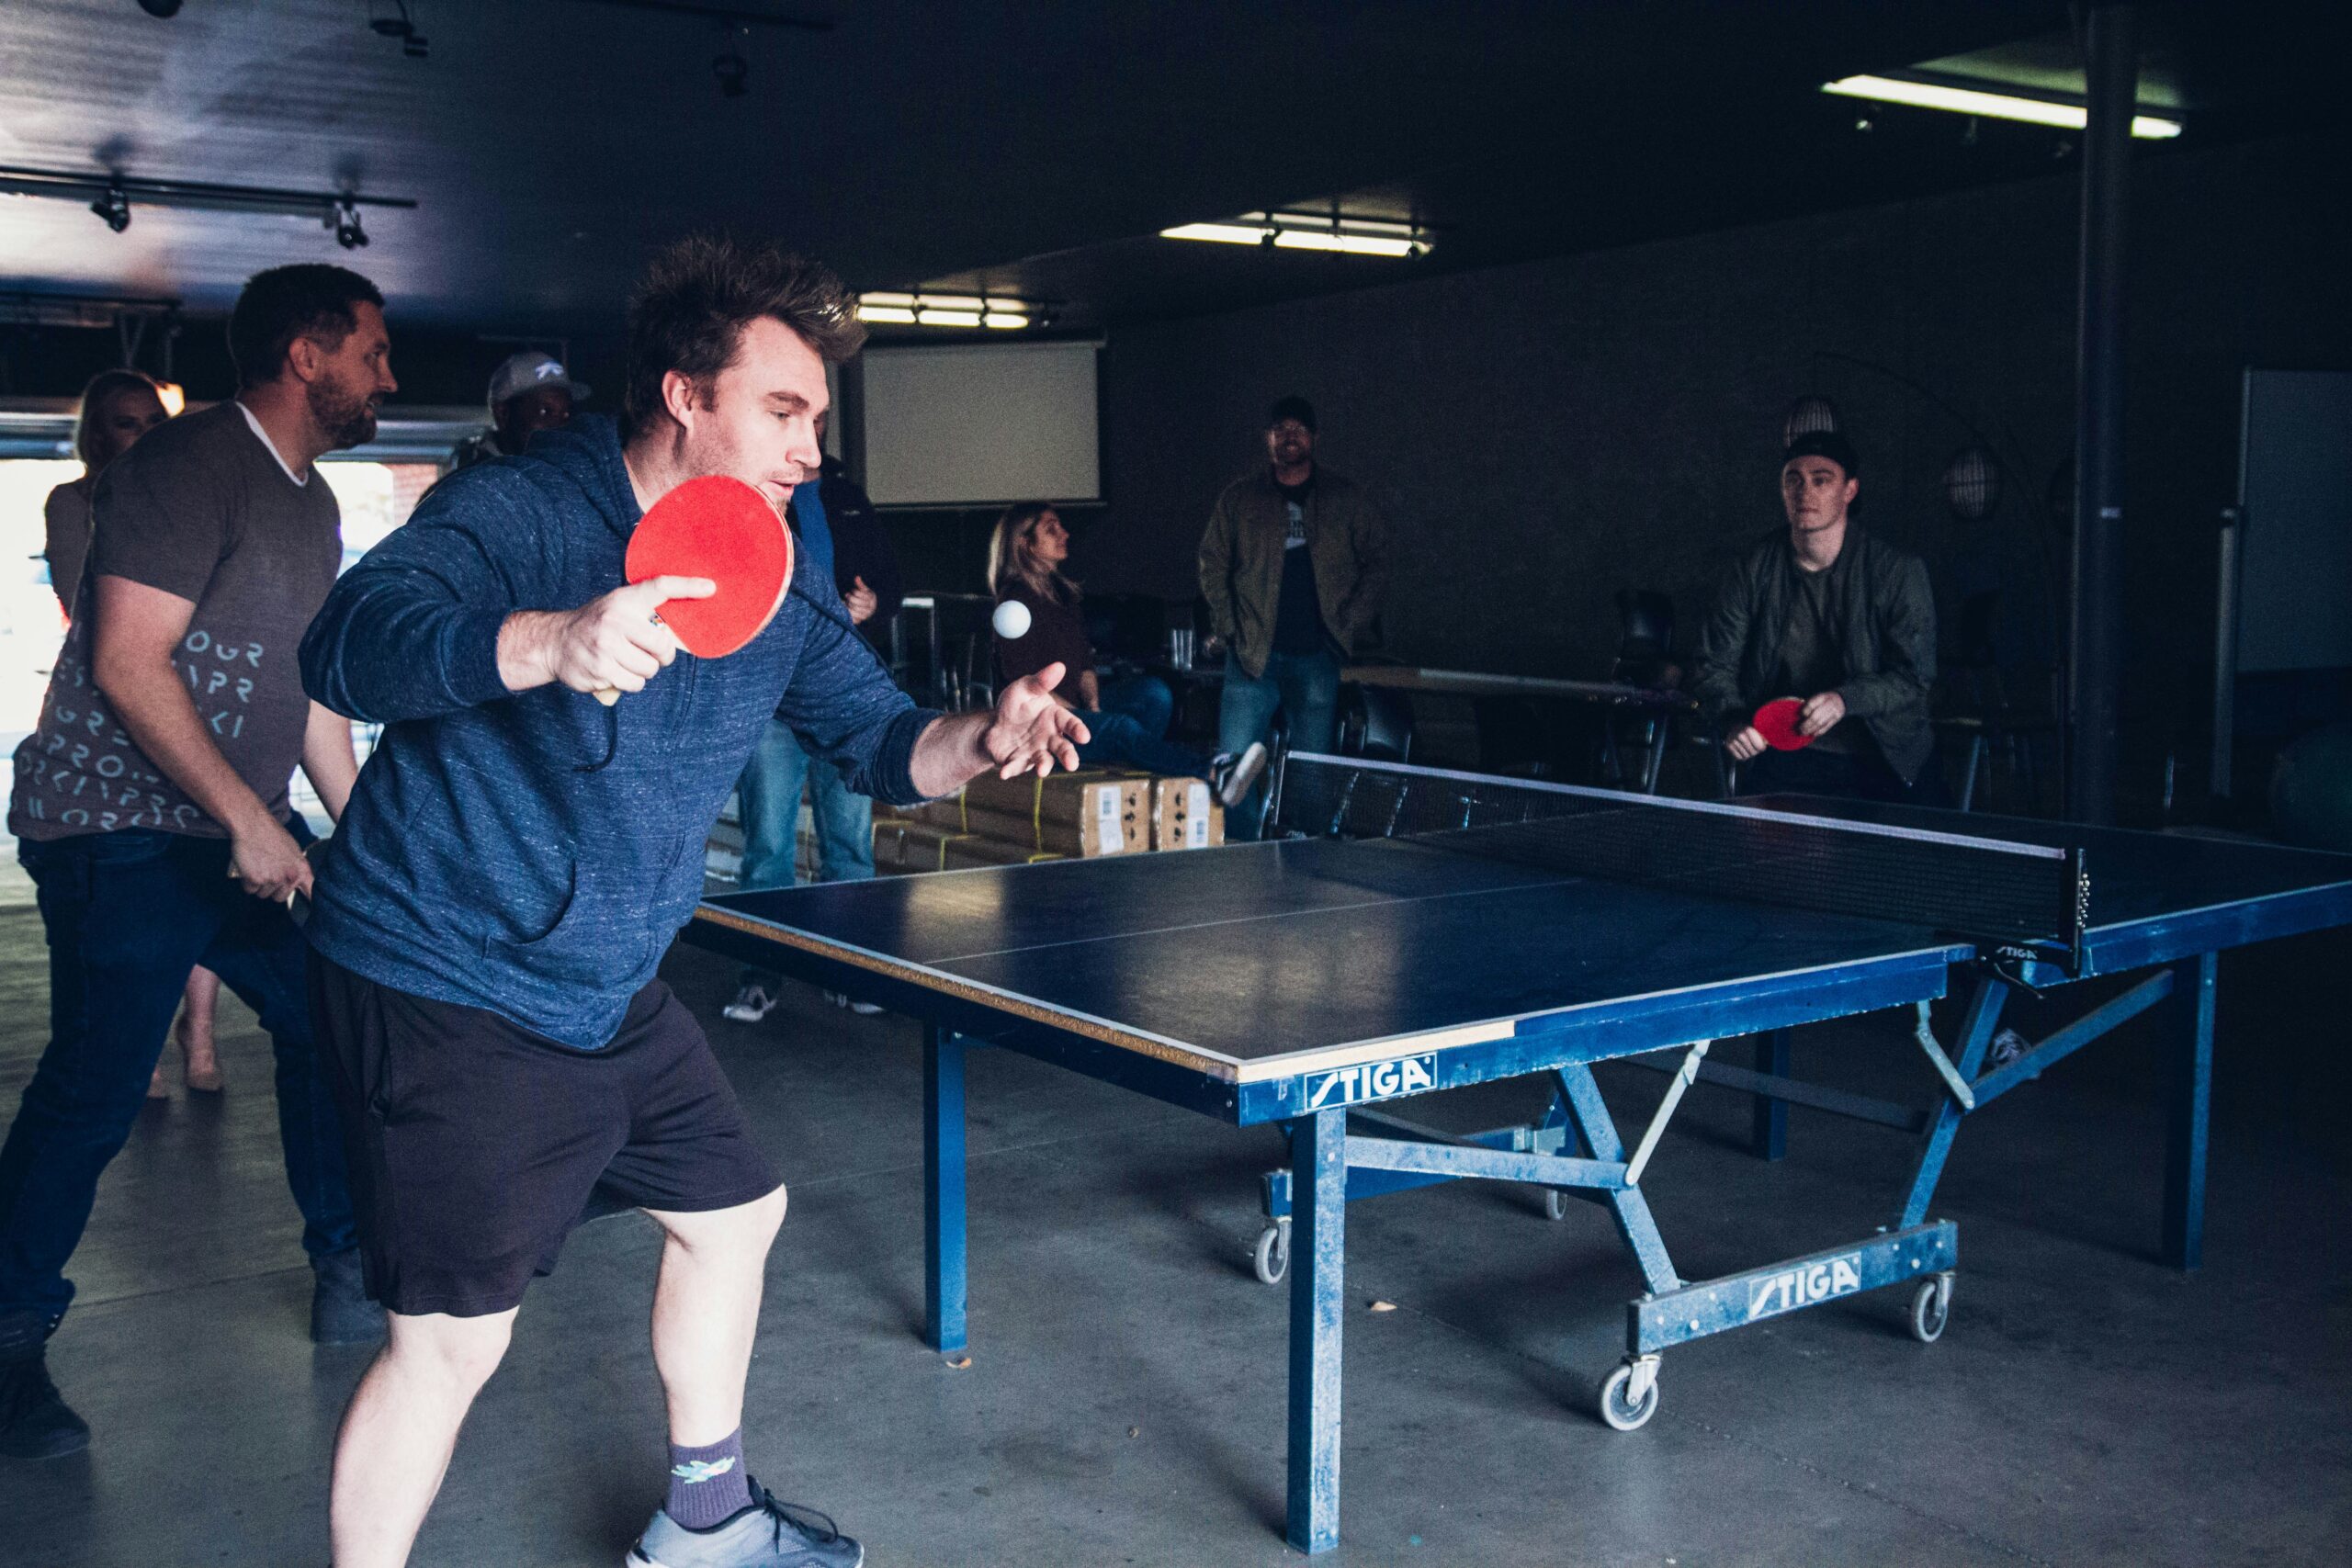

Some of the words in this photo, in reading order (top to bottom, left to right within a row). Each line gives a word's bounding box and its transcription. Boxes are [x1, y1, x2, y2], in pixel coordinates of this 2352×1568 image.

[1996, 946, 2038, 960] STIGA
[1311, 1057, 1431, 1109] STIGA
[1751, 1259, 1859, 1317] STIGA
